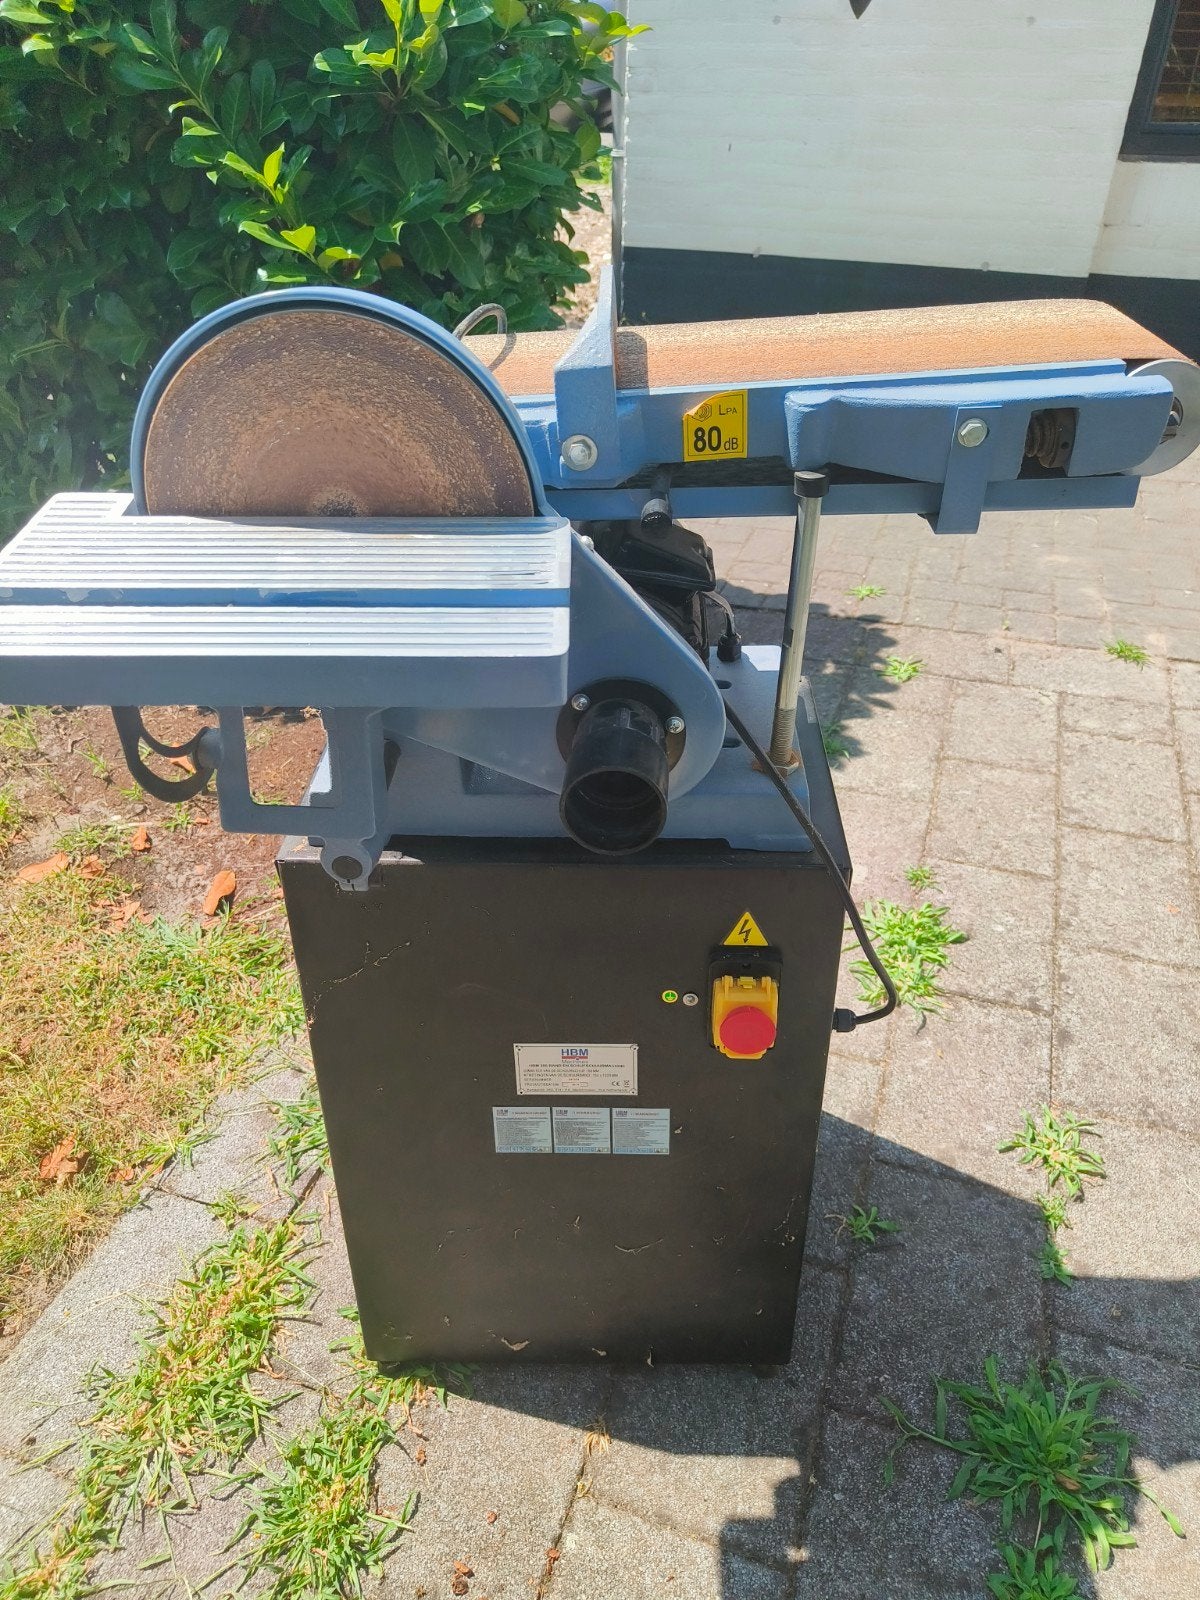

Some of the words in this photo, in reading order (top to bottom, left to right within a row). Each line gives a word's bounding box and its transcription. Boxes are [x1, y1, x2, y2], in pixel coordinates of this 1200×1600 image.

[693, 426, 722, 453] 80
[723, 437, 739, 451] dB
[561, 1048, 589, 1056] HBM
